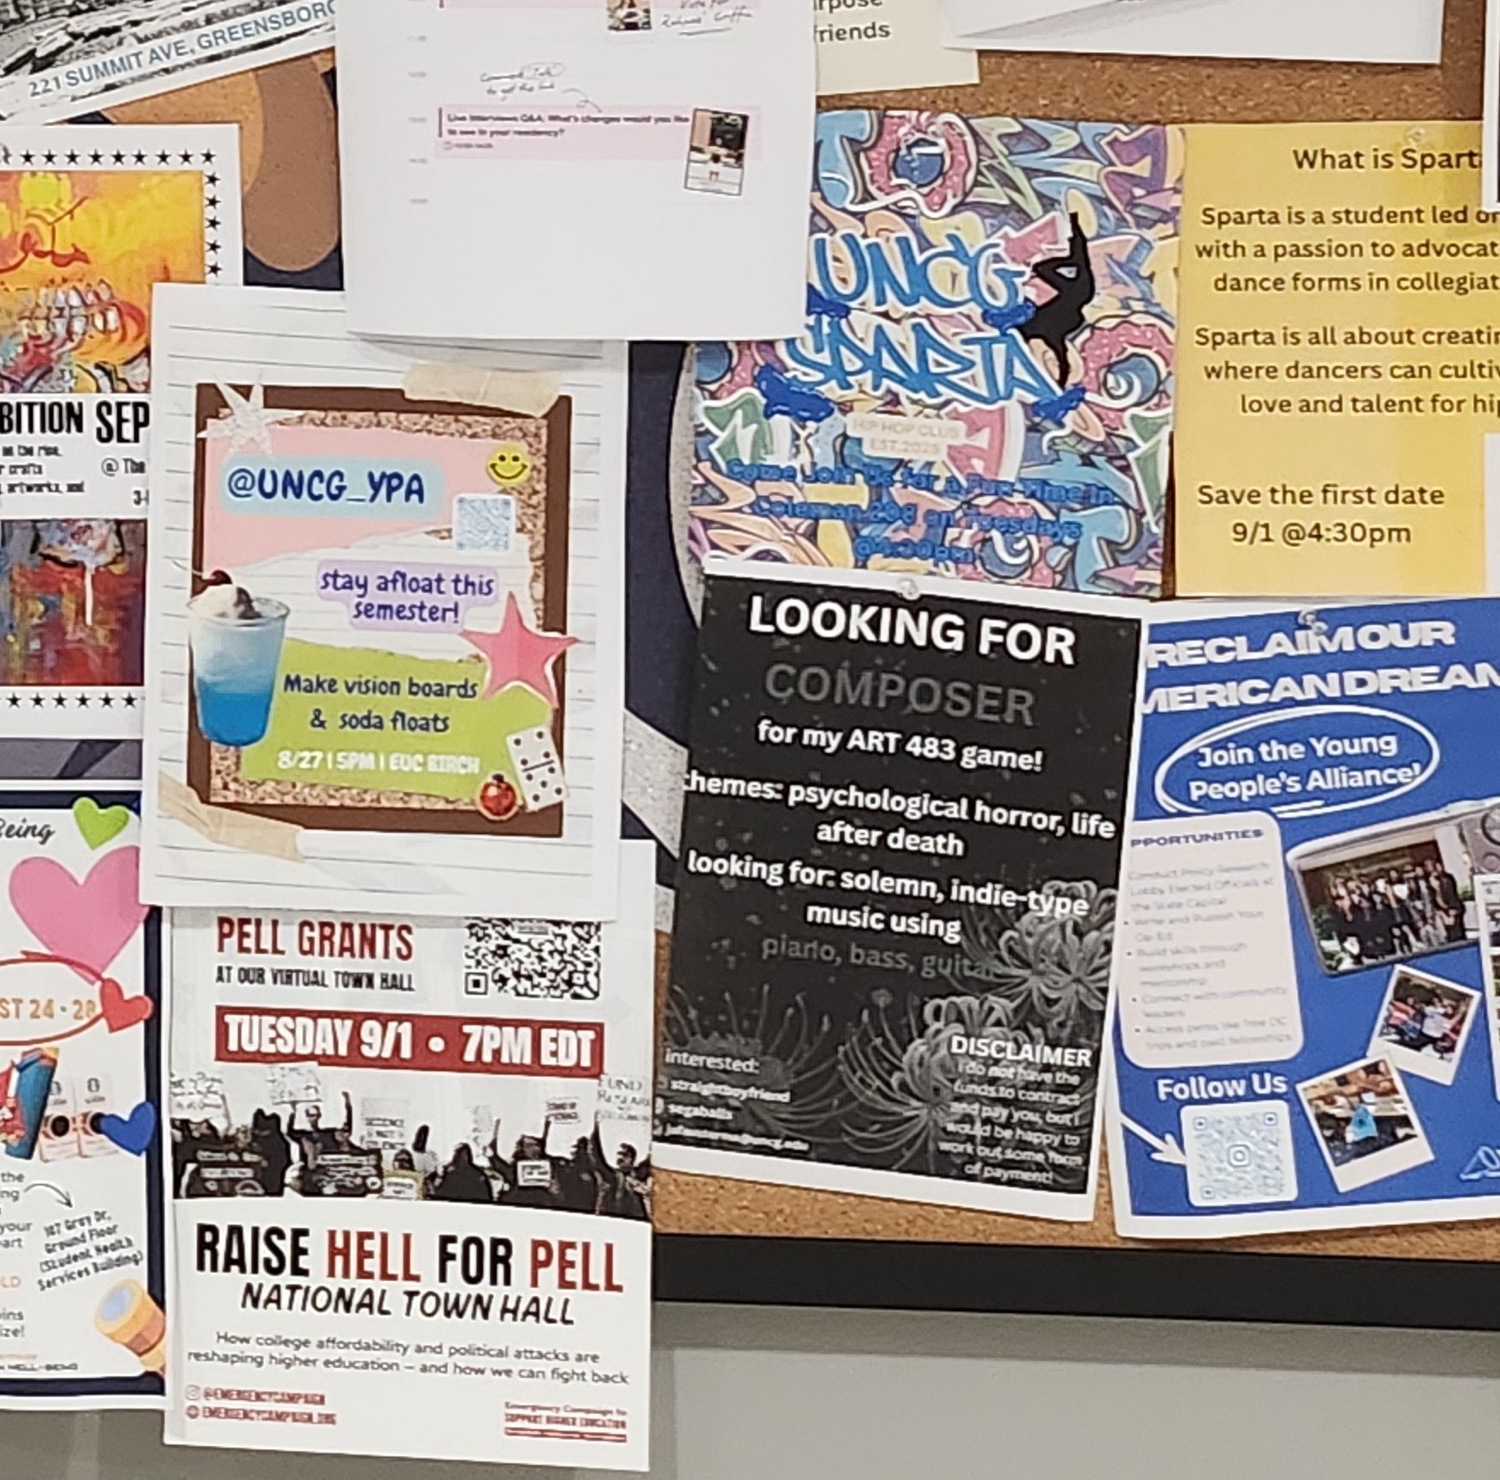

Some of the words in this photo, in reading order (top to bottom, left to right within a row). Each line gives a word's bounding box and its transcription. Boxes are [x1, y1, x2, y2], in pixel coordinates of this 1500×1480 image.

[28, 71, 62, 99] 221
[65, 51, 144, 89] SUMMIT
[147, 38, 195, 72] AVE,
[1202, 207, 1280, 229] Sparta
[1287, 207, 1305, 226] is
[1313, 210, 1326, 226] a
[1332, 207, 1425, 225] student
[1432, 206, 1468, 225] led
[813, 233, 1028, 312] UNCG
[783, 327, 1066, 403] SPARTA
[227, 468, 426, 504] @UNCG_YPA
[1199, 485, 1261, 506] Save
[1269, 485, 1313, 505] the
[1322, 485, 1377, 506] first
[1384, 485, 1445, 505] date
[1232, 522, 1274, 544] 9/1
[1282, 523, 1412, 548] @4:30pm
[320, 570, 368, 597] stay
[377, 572, 447, 595] afloat
[453, 573, 495, 596] this
[353, 601, 460, 623] semester!
[748, 595, 965, 653] LOOKING
[979, 618, 1077, 666] FOR
[284, 675, 337, 694] Make
[344, 676, 401, 696] vision
[408, 677, 478, 700] boards
[765, 662, 1036, 726] COMPOSER
[757, 720, 796, 745] for
[801, 725, 842, 754] my
[849, 731, 901, 755] ART
[906, 736, 956, 762] 483
[961, 742, 1043, 773] game!
[1197, 743, 1253, 768] Join
[1258, 739, 1306, 763] the
[1311, 732, 1398, 760] Young
[1188, 771, 1299, 802] People's
[1306, 762, 1421, 792] Alliance!
[816, 820, 882, 848] after
[887, 829, 964, 856] death
[217, 917, 285, 956] PELL
[298, 919, 414, 960] GRANTS
[224, 1014, 353, 1055] TUESDAY
[359, 1021, 413, 1059] 9/1
[462, 1024, 532, 1064] 7PM
[540, 1028, 597, 1067] EDT
[1156, 1073, 1240, 1101] Follow
[1248, 1073, 1288, 1095] Us
[195, 1223, 310, 1277] RAISE
[327, 1229, 421, 1283] HELL
[438, 1234, 513, 1287] FOR
[529, 1238, 624, 1293] PELL
[240, 1282, 391, 1317] NATIONAL
[403, 1289, 492, 1322] TOWN
[499, 1294, 574, 1325] HALL
[216, 1330, 251, 1345] How
[255, 1332, 312, 1351] college
[315, 1335, 410, 1356] affordability
[414, 1340, 444, 1354] and
[448, 1341, 509, 1361] political
[513, 1347, 569, 1364] attacks
[574, 1351, 599, 1364] are
